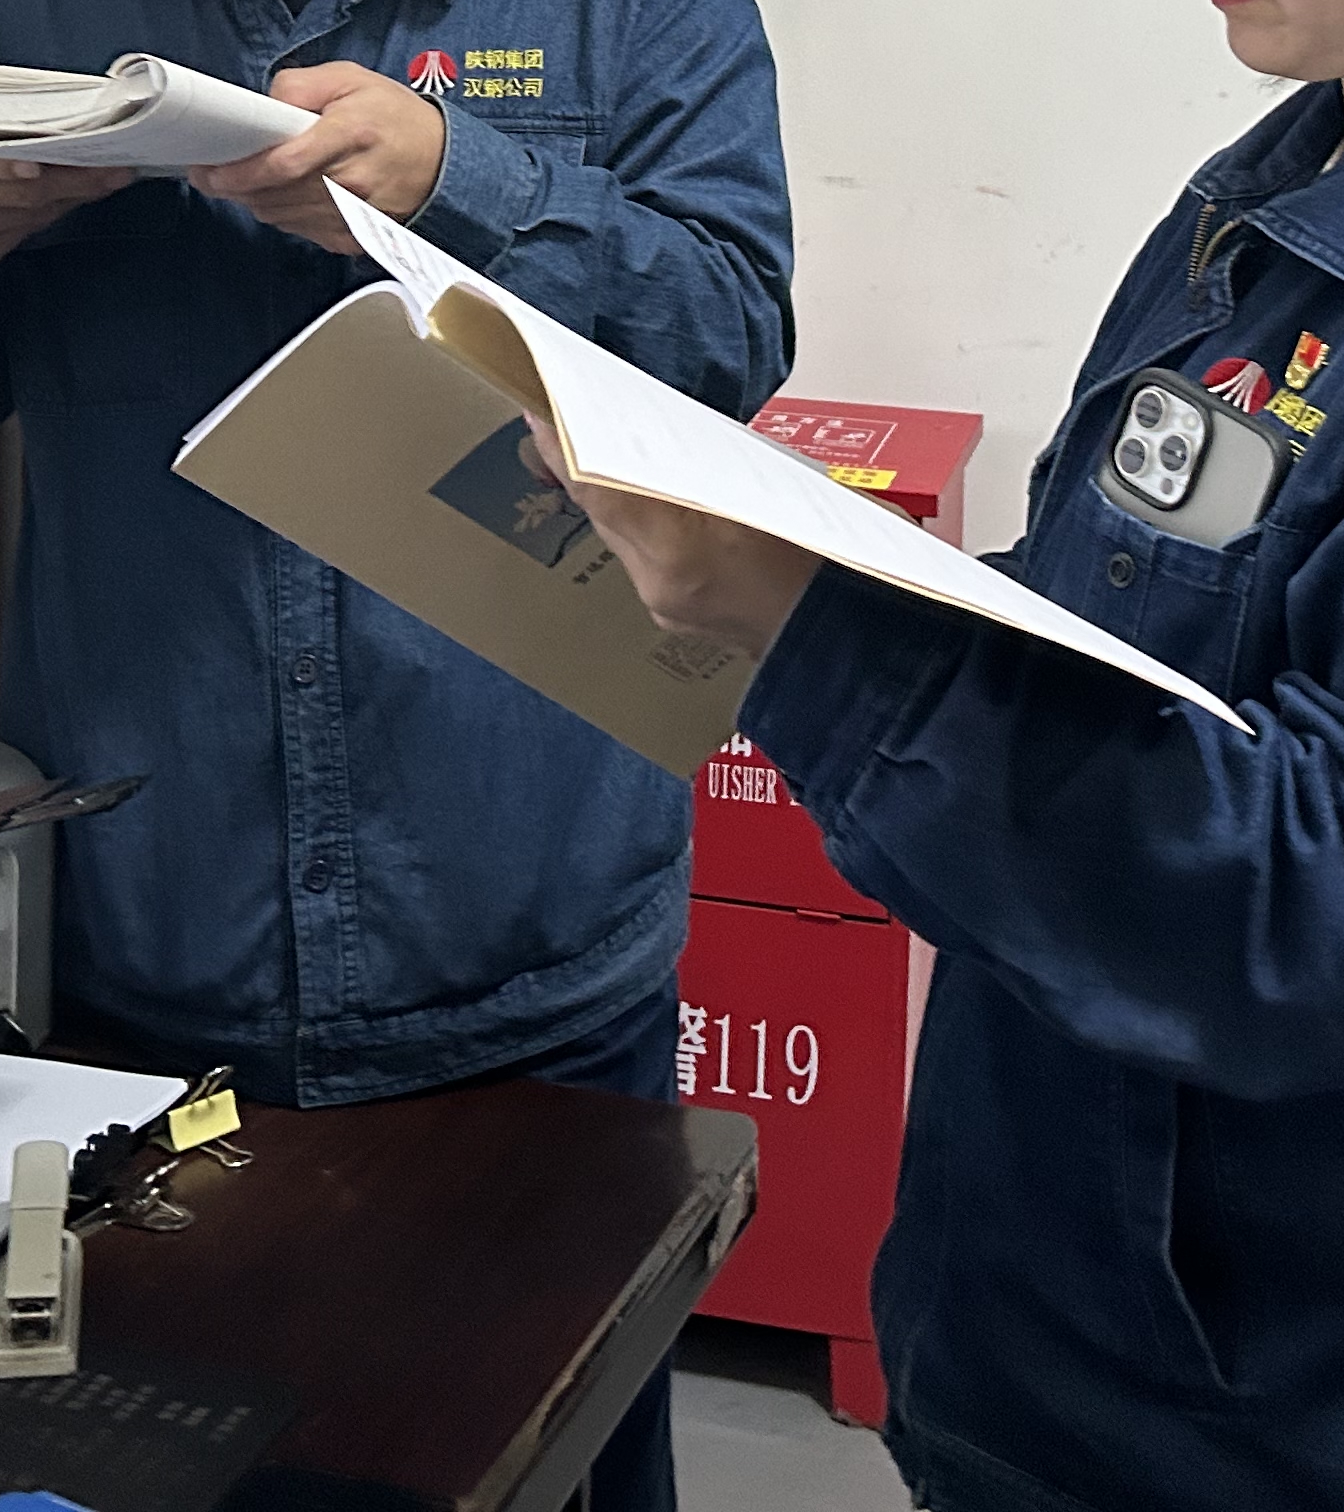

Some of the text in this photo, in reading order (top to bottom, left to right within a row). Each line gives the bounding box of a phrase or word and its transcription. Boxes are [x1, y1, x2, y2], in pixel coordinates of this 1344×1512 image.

[464, 48, 544, 70] 陕钢集团
[463, 77, 544, 98] 汉钢公司
[707, 762, 777, 804] UISHER
